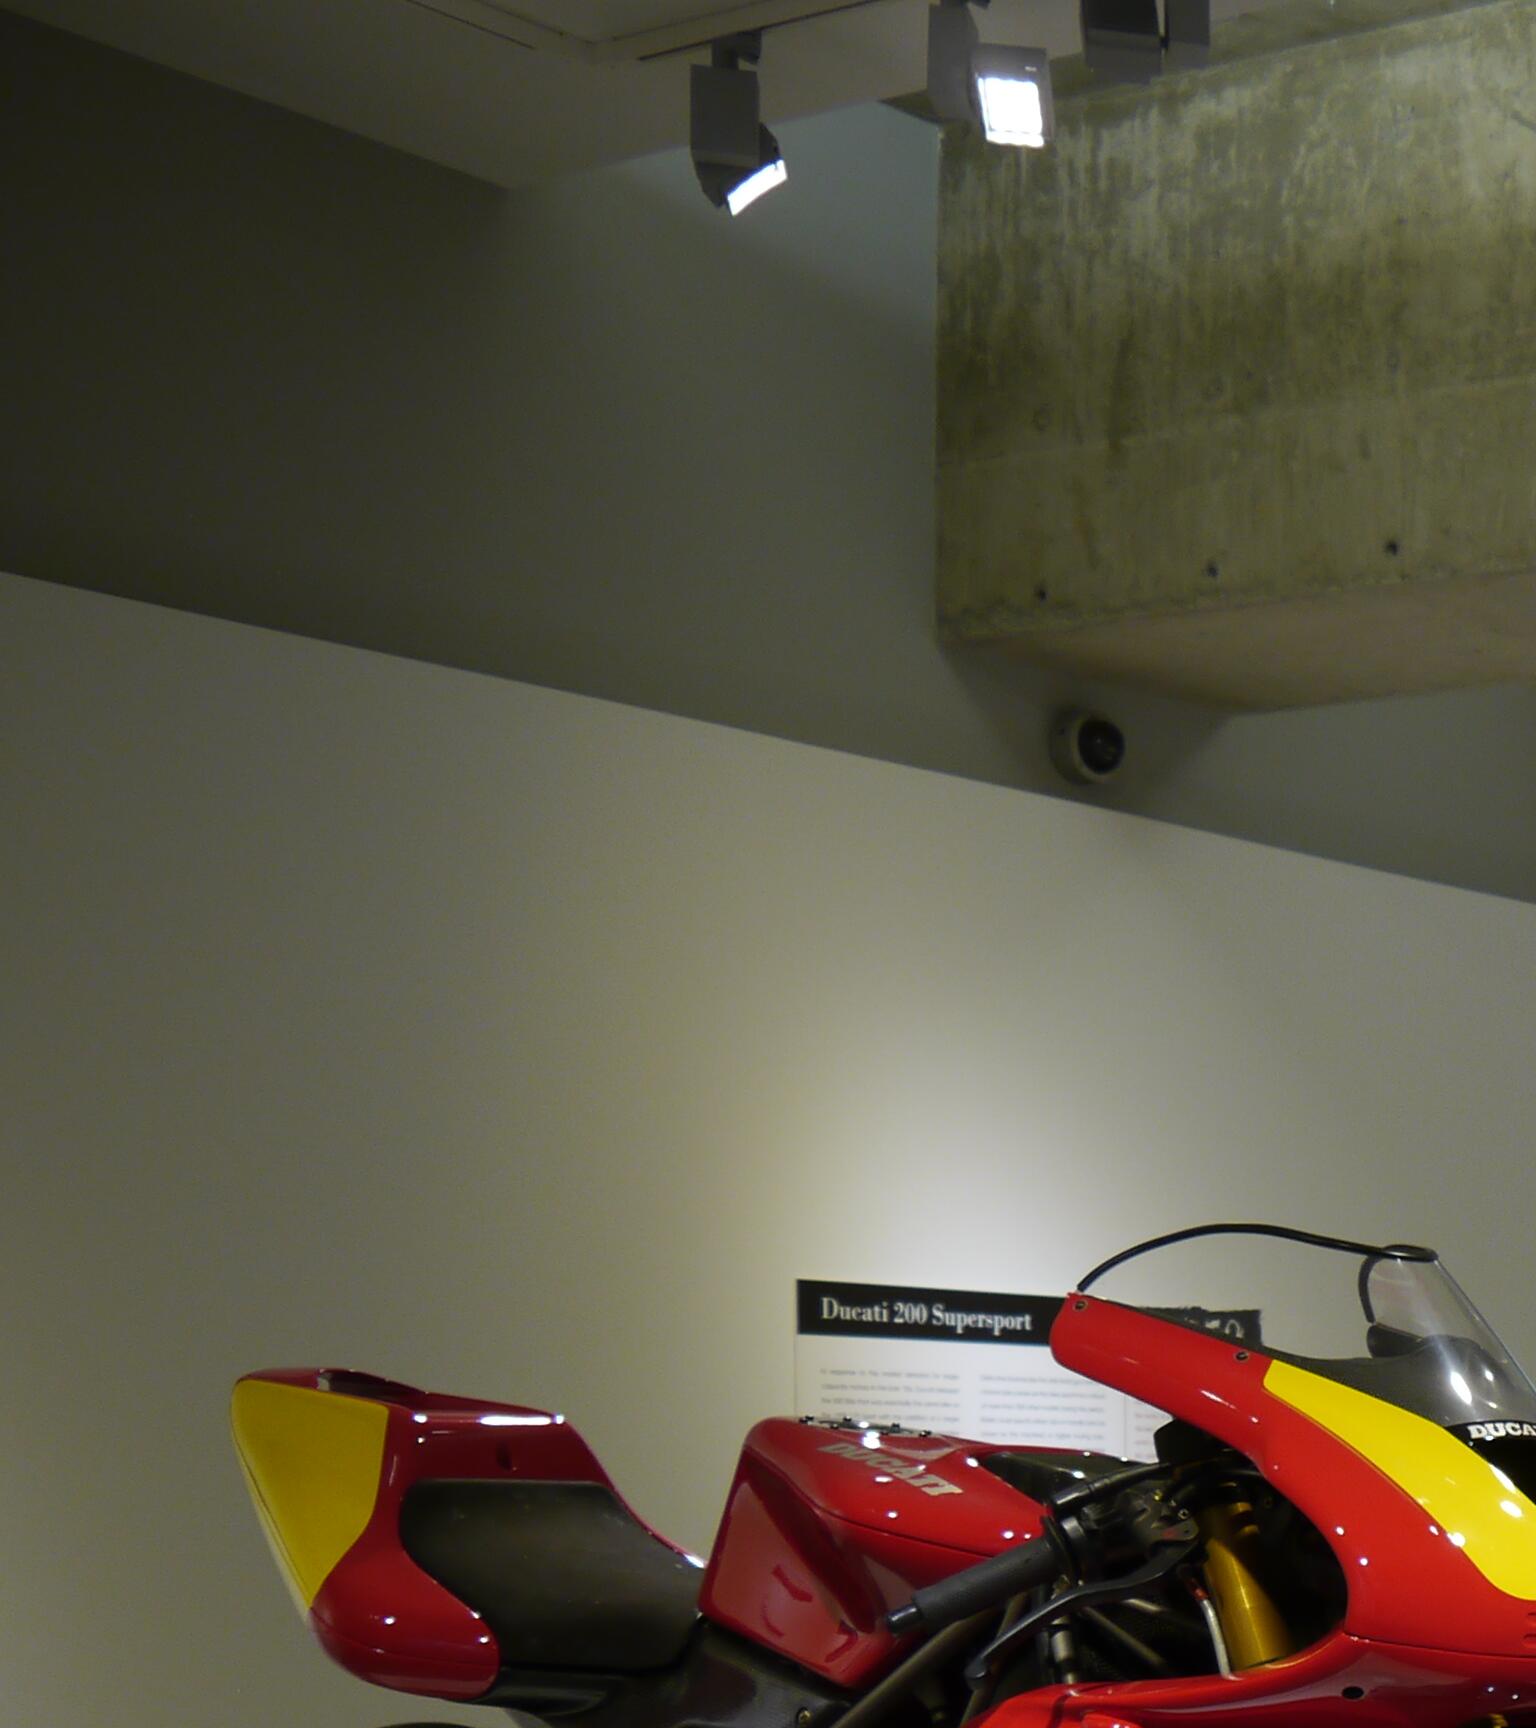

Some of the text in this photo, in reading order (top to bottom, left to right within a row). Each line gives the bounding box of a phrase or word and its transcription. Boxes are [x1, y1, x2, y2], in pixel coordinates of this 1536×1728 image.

[820, 1296, 1033, 1337] Ducati 200 Supersport
[817, 1442, 964, 1496] DUCATI
